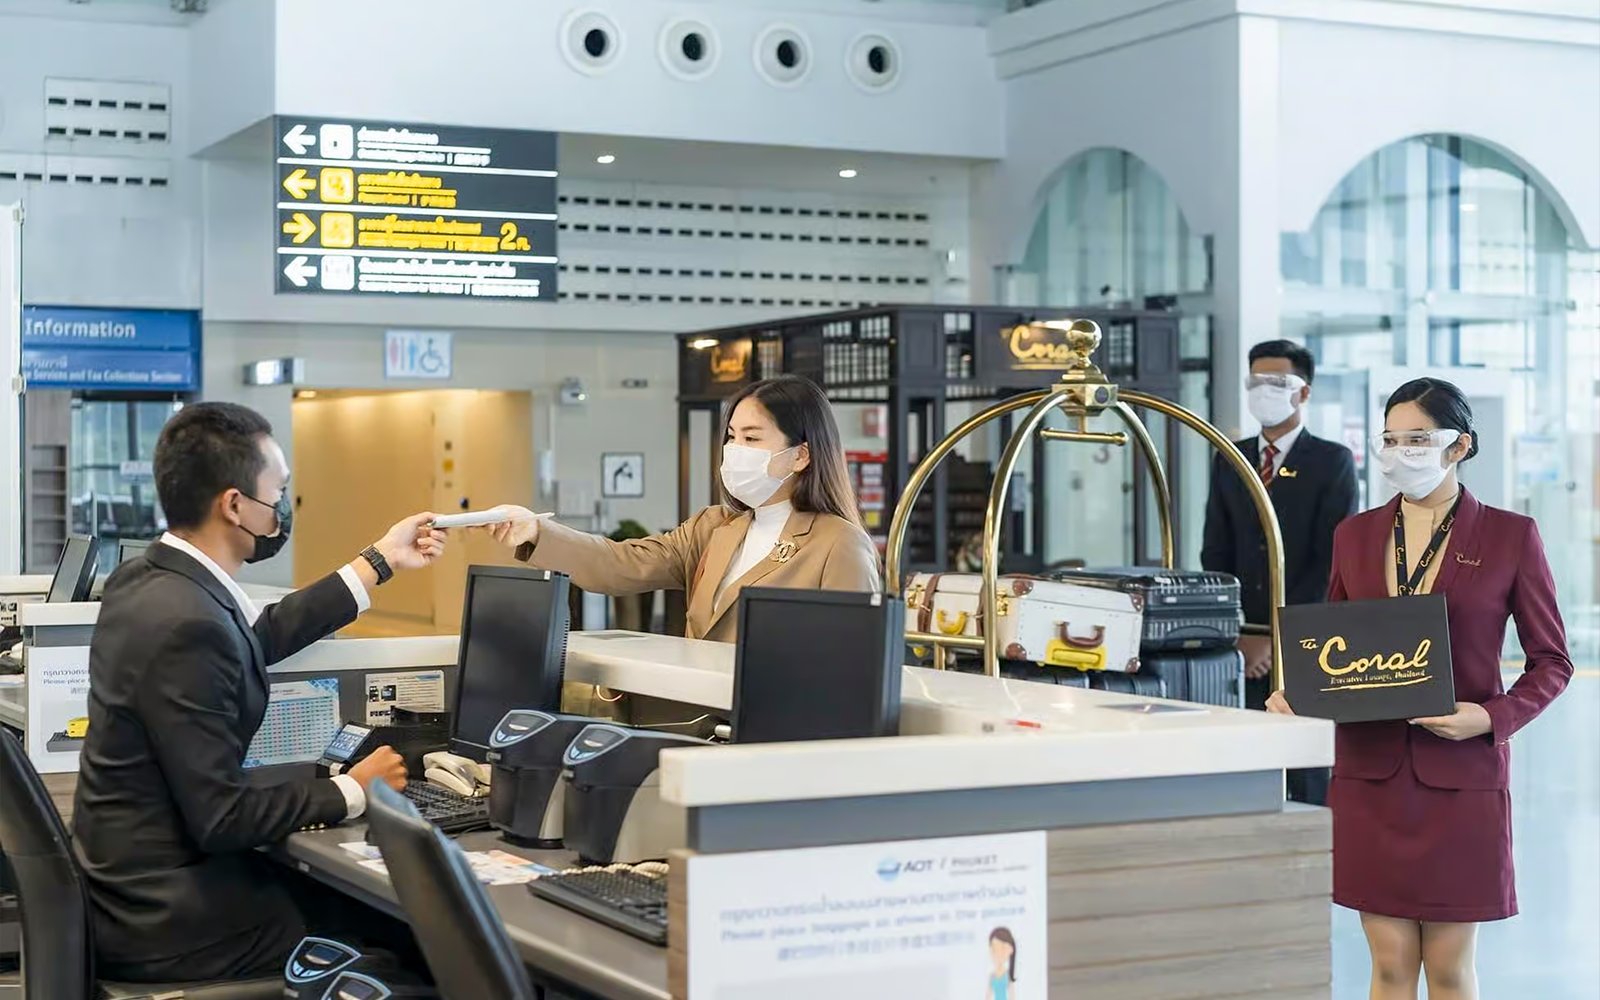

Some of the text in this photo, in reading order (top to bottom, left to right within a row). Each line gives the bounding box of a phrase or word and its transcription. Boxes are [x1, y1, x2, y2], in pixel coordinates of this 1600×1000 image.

[25, 318, 136, 338] Information
[1010, 325, 1078, 360] Cora
[1318, 636, 1432, 675] Coral
[904, 860, 933, 873] AOT
[721, 929, 765, 943] Please
[771, 926, 806, 940] place
[811, 920, 870, 934] baggage
[981, 906, 1026, 920] picture
